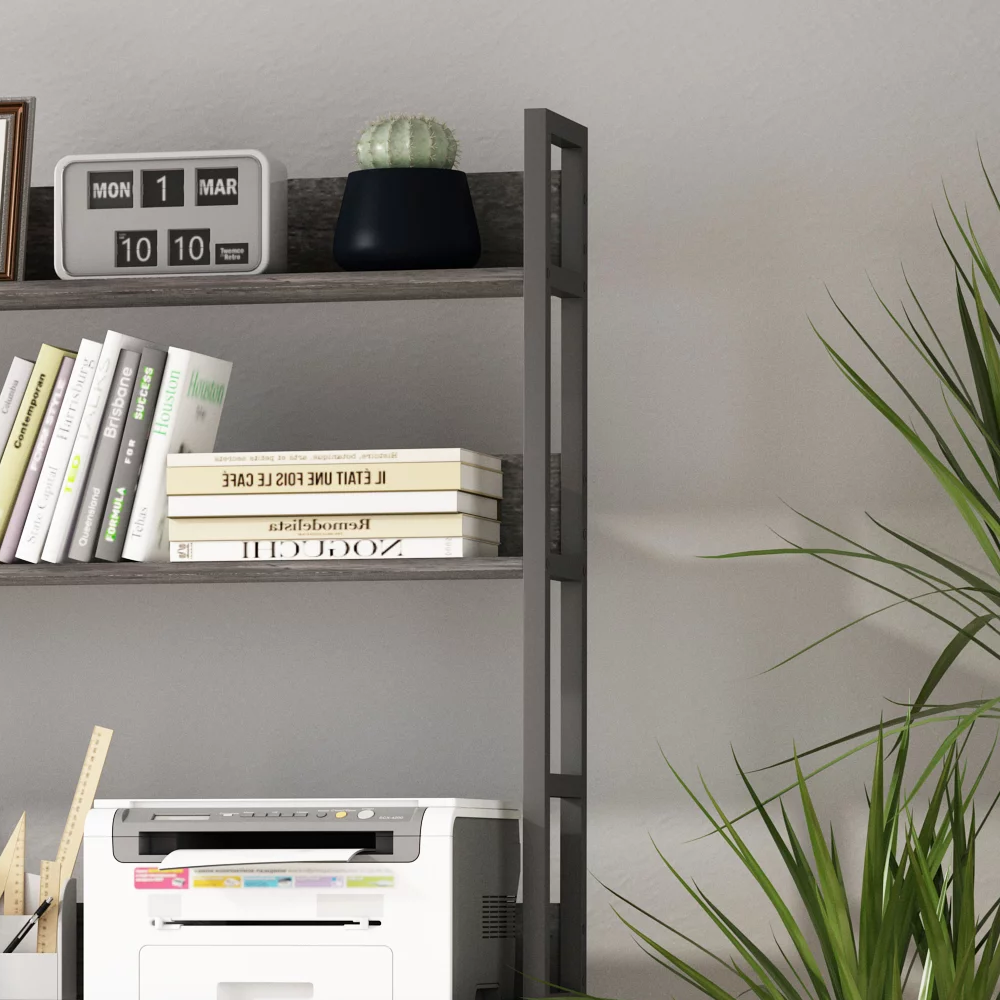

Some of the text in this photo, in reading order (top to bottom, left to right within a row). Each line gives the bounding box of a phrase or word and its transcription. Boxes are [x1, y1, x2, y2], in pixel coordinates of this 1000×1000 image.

[92, 175, 238, 202] MON 1 MAR
[122, 235, 204, 262] 10 10
[13, 373, 46, 449] Contemporan
[56, 357, 95, 440] Harrisburg
[103, 366, 133, 439] Brisbane
[153, 370, 181, 436] Houston
[104, 366, 154, 542] FORMULA FOR SUCCESS
[78, 487, 101, 547] Queensland
